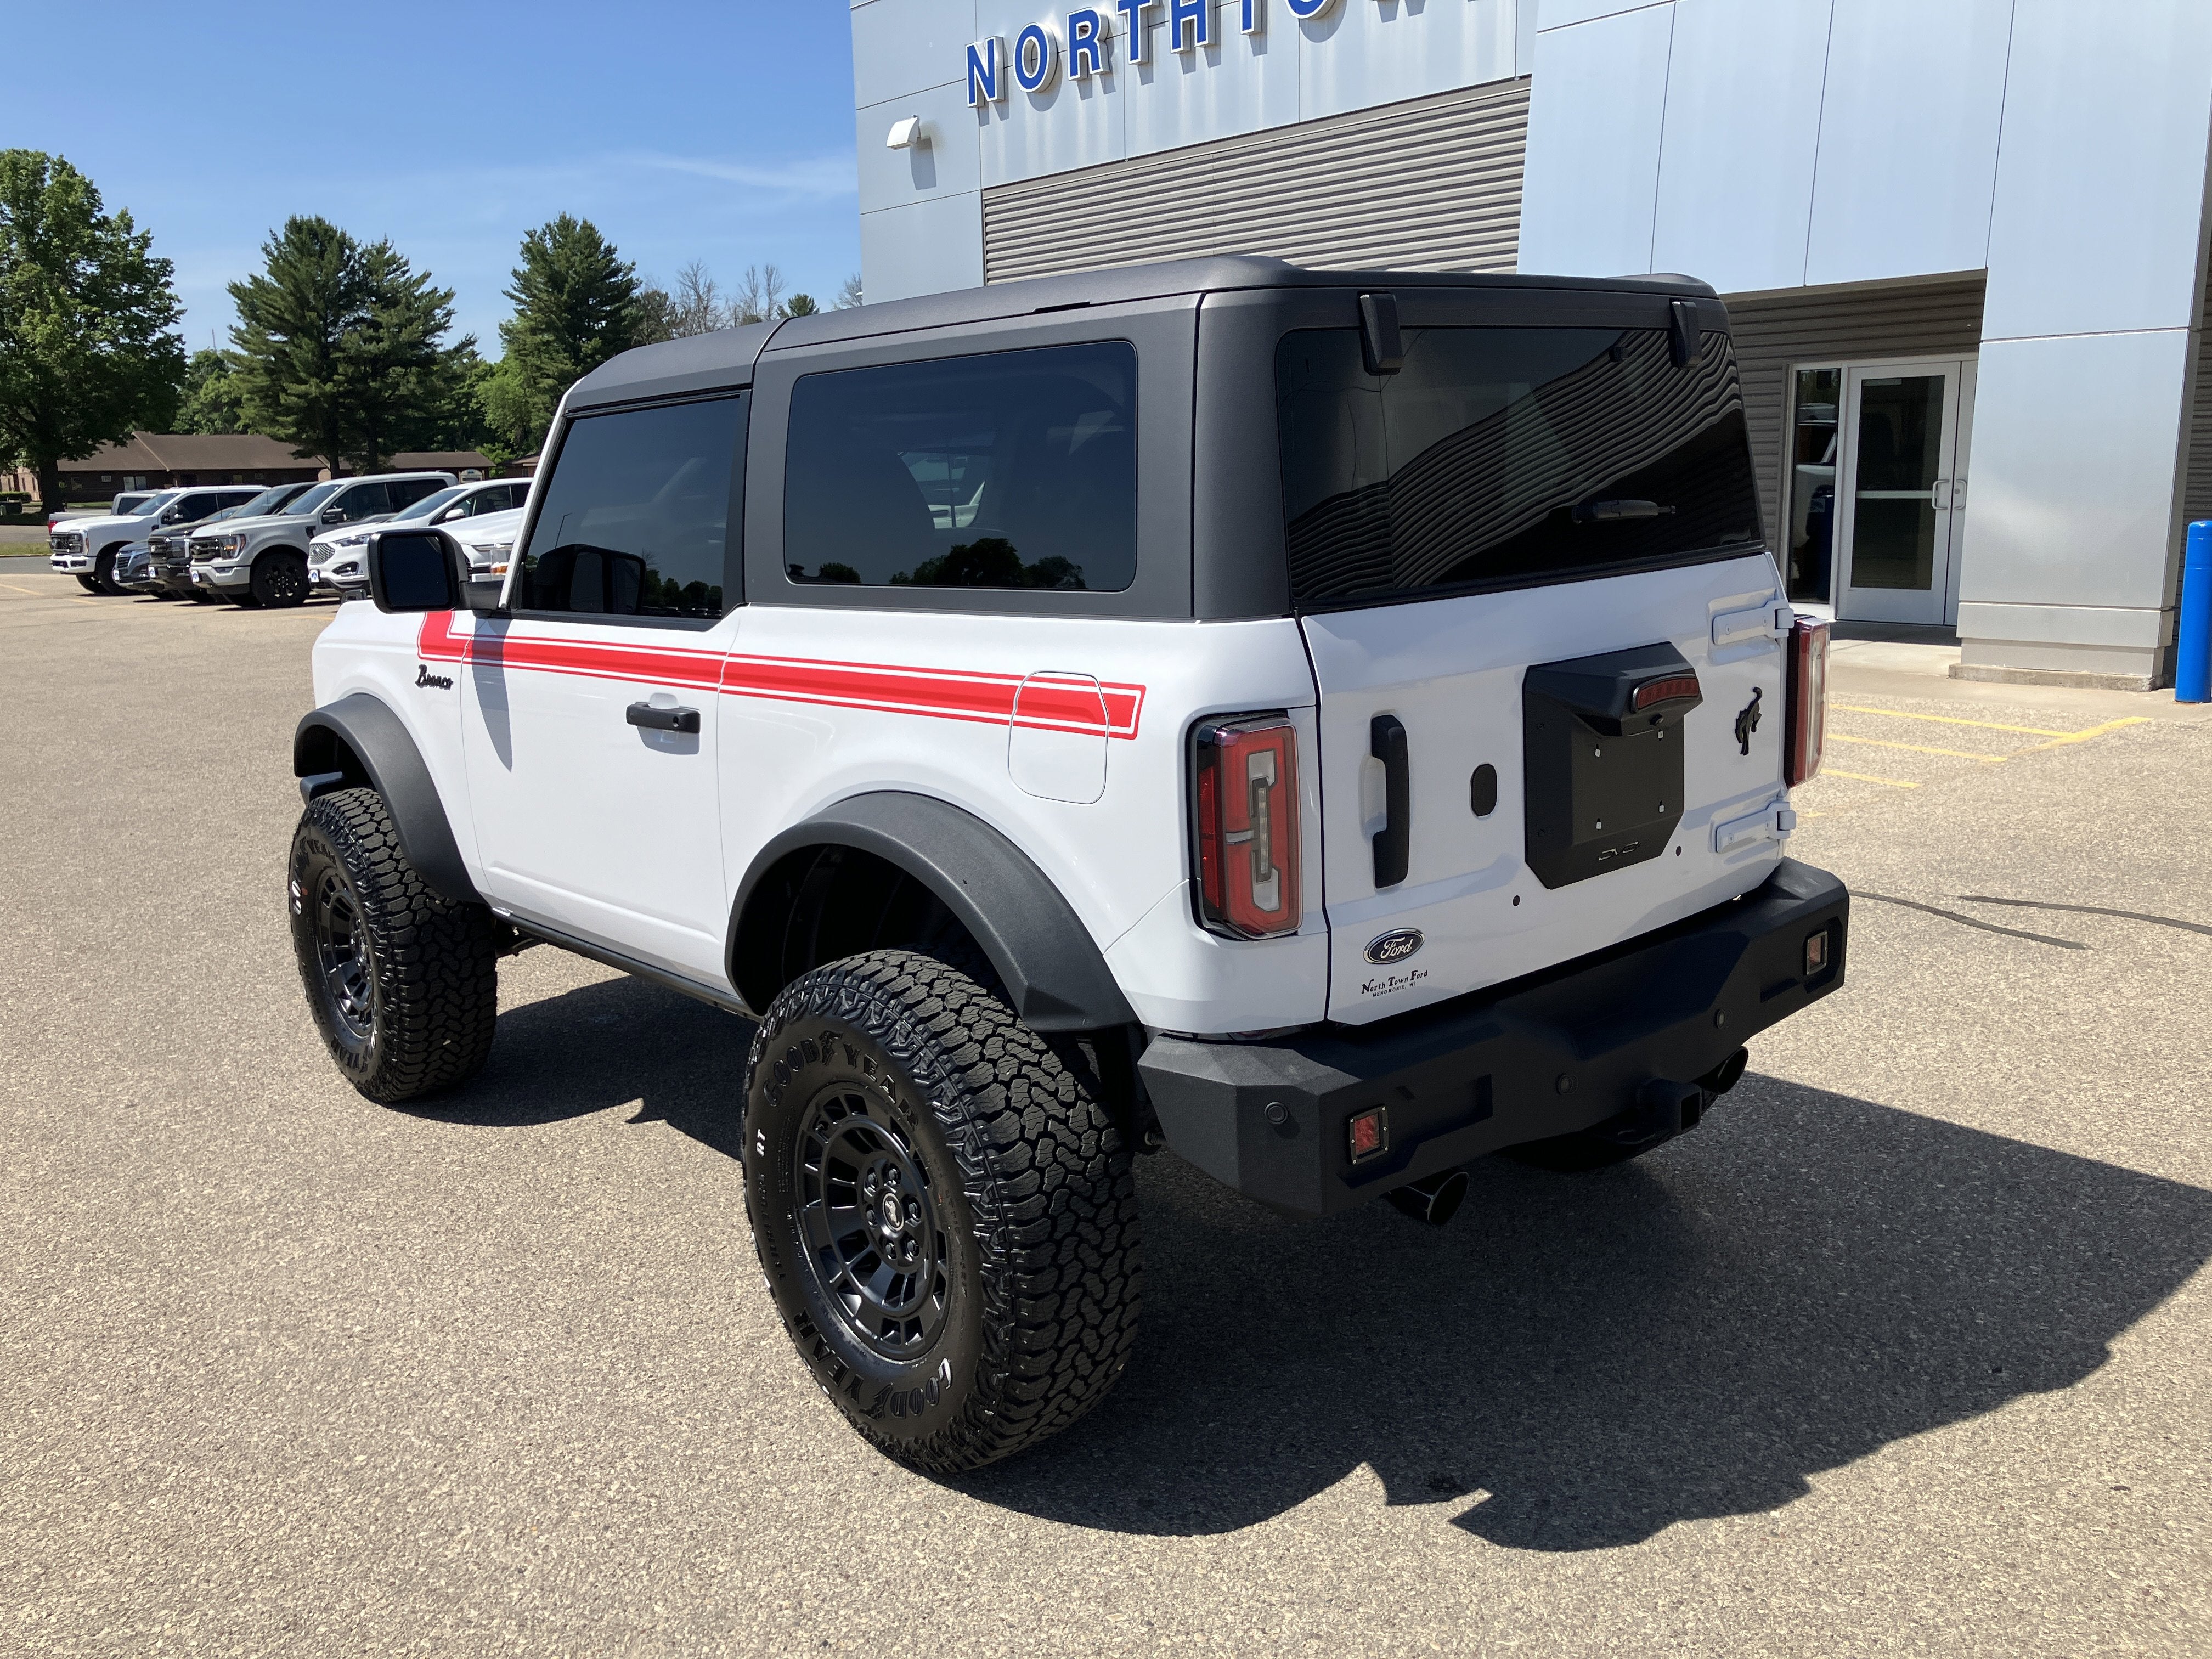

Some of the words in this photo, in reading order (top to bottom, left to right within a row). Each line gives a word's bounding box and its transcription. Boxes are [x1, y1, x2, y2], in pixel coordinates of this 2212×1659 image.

[415, 664, 453, 690] Bronco
[1380, 936, 1413, 959] Ford
[1361, 978, 1386, 994] North
[1388, 976, 1408, 987] Town
[1410, 969, 1428, 981] Ford
[755, 1128, 766, 1157] RT
